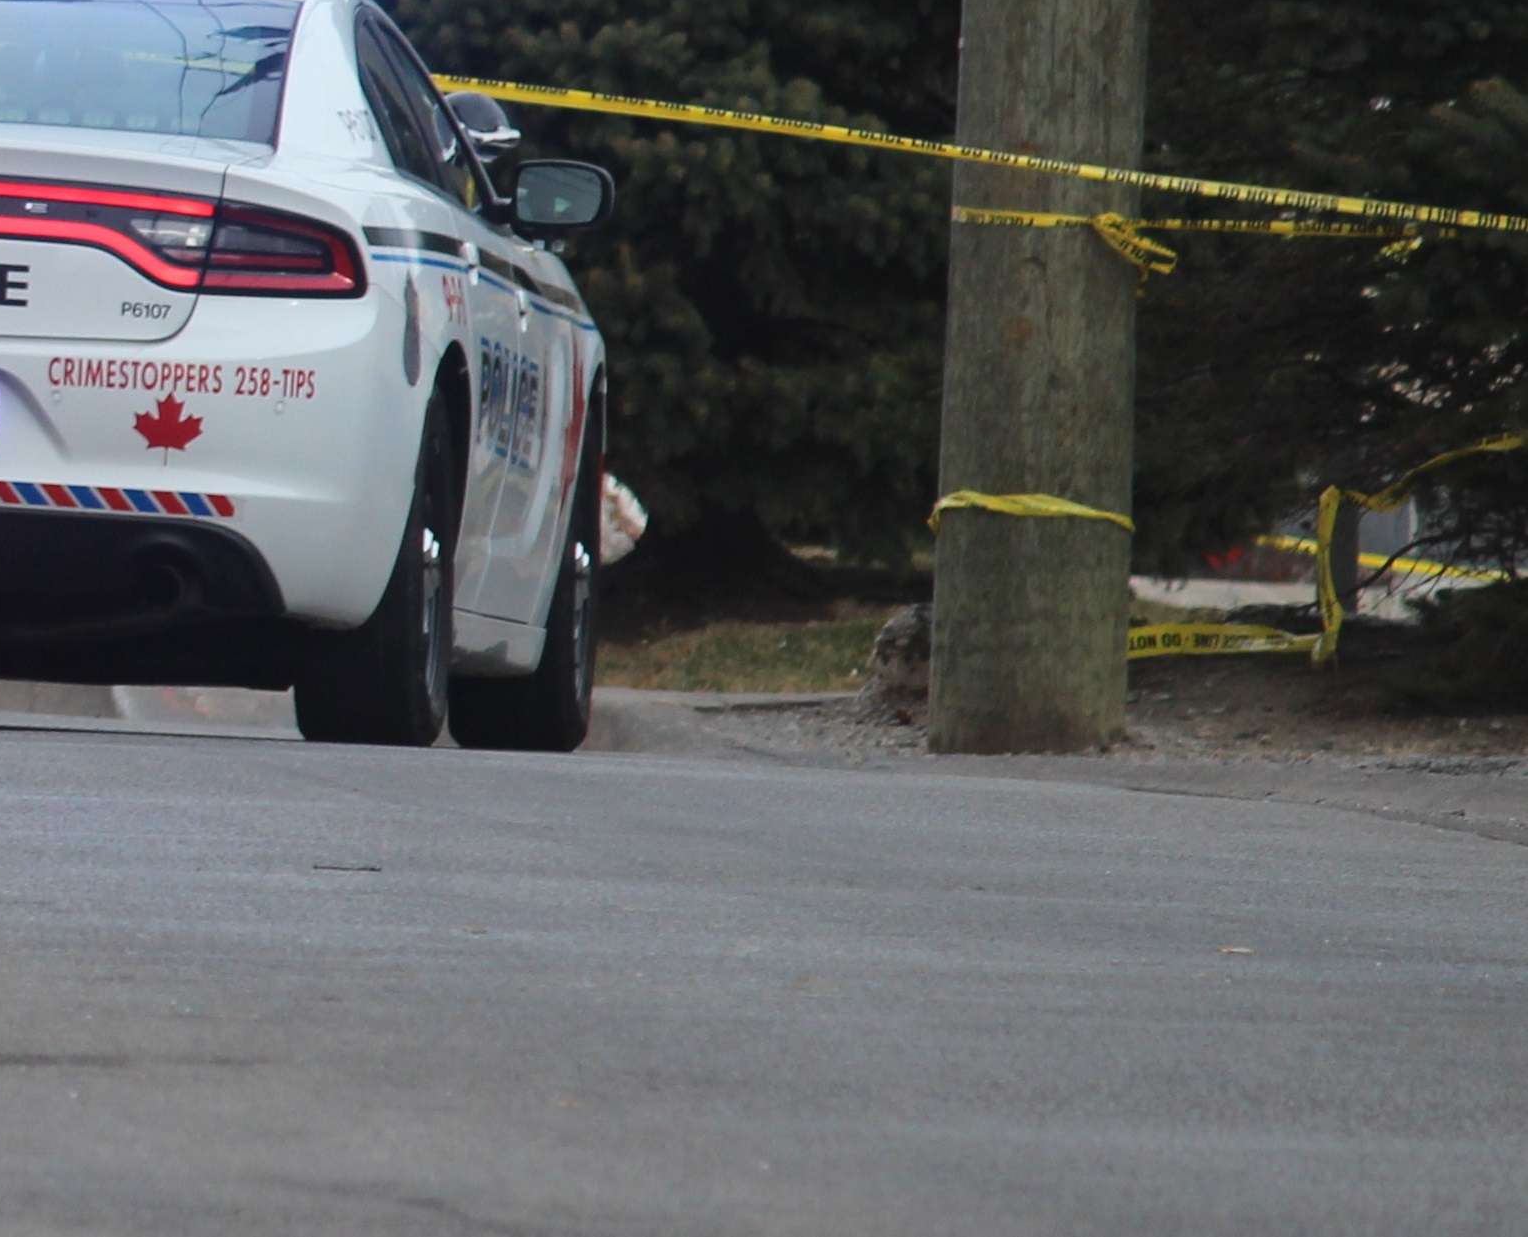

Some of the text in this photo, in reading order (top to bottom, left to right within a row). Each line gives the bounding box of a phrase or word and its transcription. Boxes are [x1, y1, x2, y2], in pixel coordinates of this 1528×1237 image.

[121, 301, 171, 320] P6107
[48, 357, 316, 400] CRIMESTOPPERS 258-TIPS
